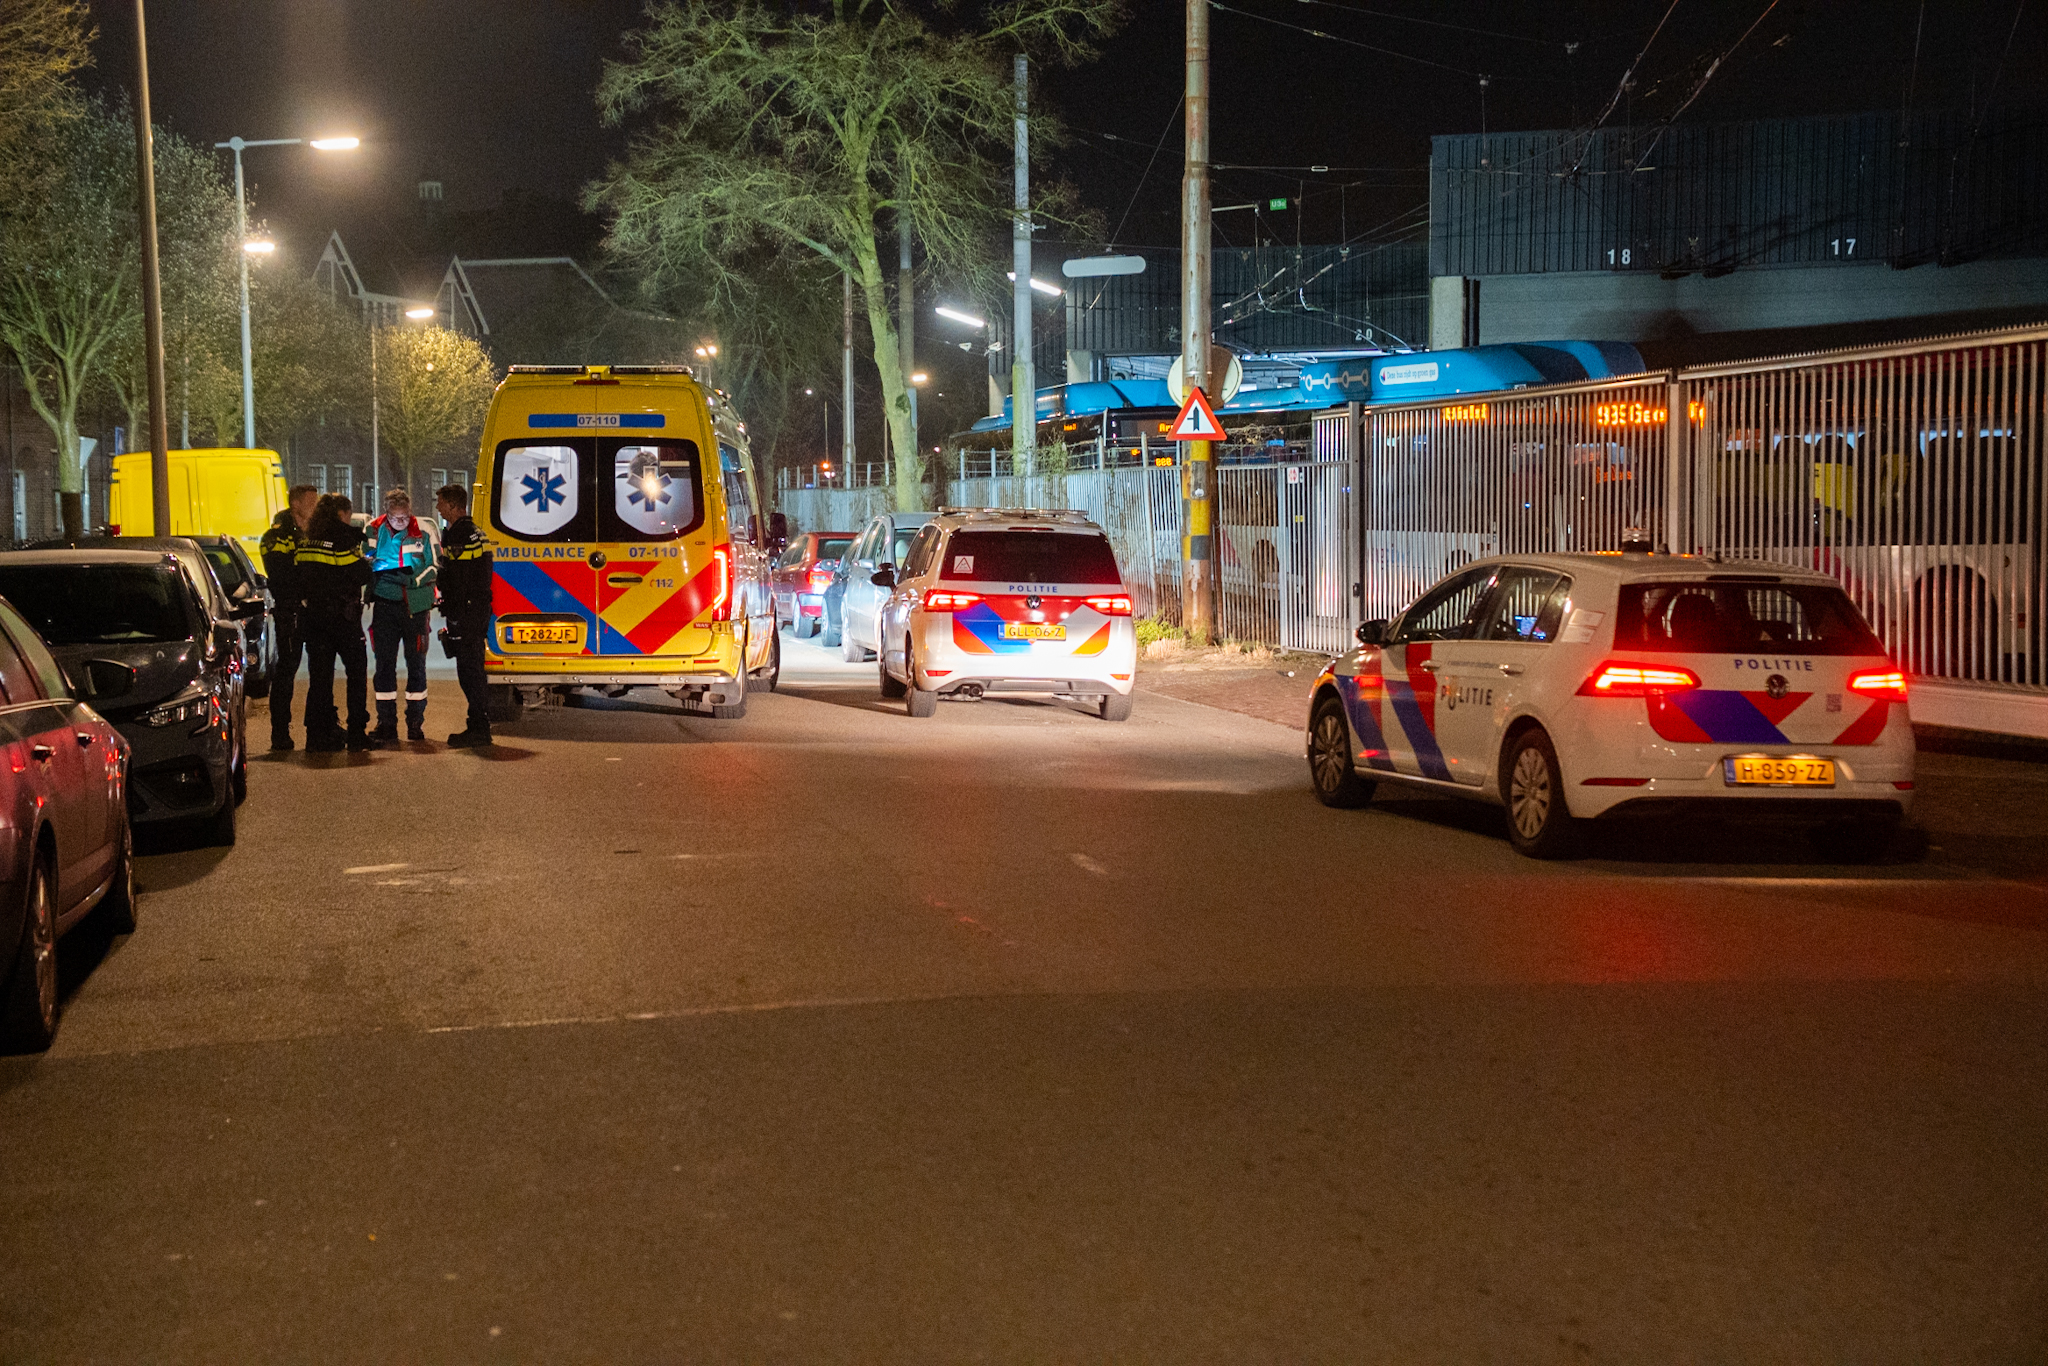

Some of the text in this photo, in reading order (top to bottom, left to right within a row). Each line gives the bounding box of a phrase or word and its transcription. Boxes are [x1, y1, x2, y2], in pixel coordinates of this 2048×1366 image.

[1831, 239, 1856, 255] 17
[1607, 249, 1631, 265] 18
[578, 416, 617, 425] 07-110
[492, 547, 586, 558] MBULANCE
[628, 547, 678, 558] 07-110
[655, 579, 674, 588] 112
[1009, 585, 1058, 593] POLITIE
[518, 628, 571, 640] T-282-JF
[1009, 626, 1062, 637] GLL-06-Z
[1734, 659, 1813, 672] POLITIE
[1440, 684, 1493, 711] POLITIE
[1741, 762, 1828, 782] H-859-ZZ
